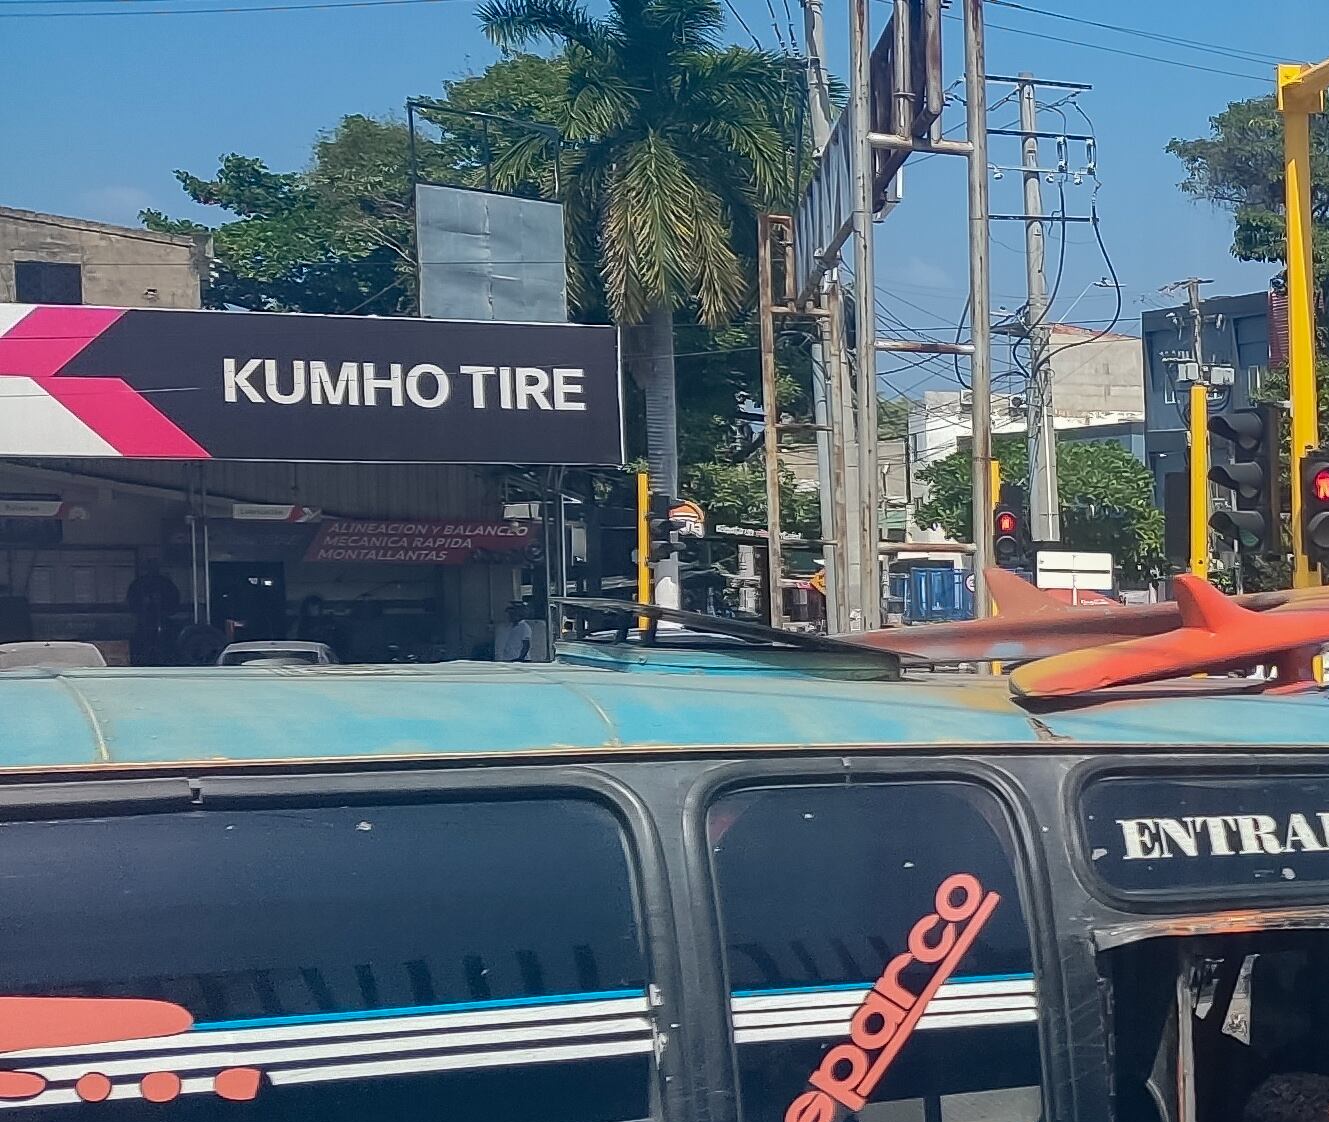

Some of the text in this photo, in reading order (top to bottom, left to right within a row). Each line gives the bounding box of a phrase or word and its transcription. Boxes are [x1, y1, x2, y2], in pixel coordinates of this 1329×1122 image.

[223, 358, 588, 411] KUMHO TIRE
[328, 522, 430, 535] ALINEACION
[323, 536, 472, 549] MECANICA RAPIDA
[317, 550, 449, 562] MONTALLANTAS
